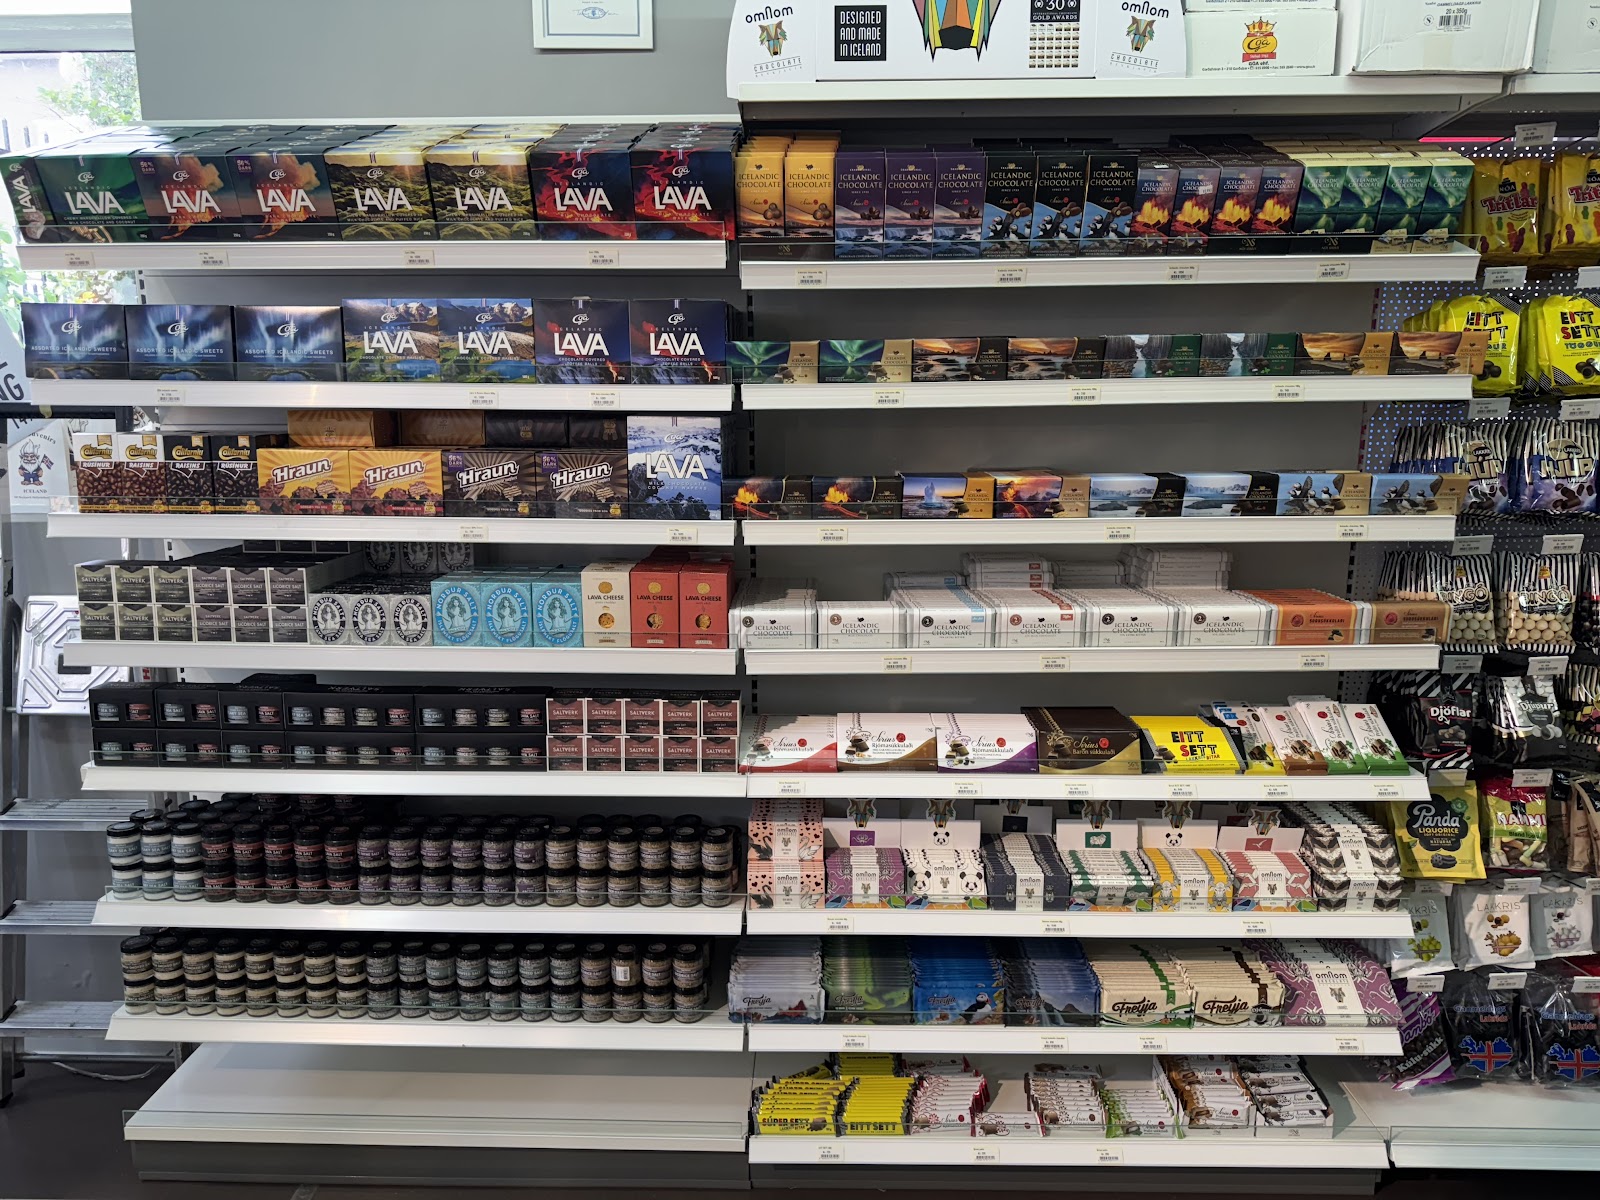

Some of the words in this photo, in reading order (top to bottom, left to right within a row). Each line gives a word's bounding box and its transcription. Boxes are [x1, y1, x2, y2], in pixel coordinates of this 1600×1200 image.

[745, 6, 793, 23] omnom
[1046, 0, 1065, 11] 30
[1121, 1, 1170, 18] omnom
[840, 11, 881, 24] DESIGNED
[840, 27, 855, 40] AND
[858, 27, 881, 40] MADE
[840, 43, 848, 56] IN
[850, 43, 881, 56] ICELAND
[840, 173, 881, 181] ICELANDIC
[890, 173, 932, 181] ICELANDIC
[987, 179, 1034, 187] CHOCOLATE
[990, 171, 1032, 179] ICELANDIC
[1038, 179, 1084, 187] CHOCOLATE
[1089, 178, 1136, 186] CHOCOLATE
[1092, 170, 1134, 178] ICELANDIC
[12, 175, 36, 212] LAVA
[837, 181, 883, 189] CHOCOLATE
[888, 181, 934, 189] CHOCOLATE
[65, 192, 125, 215] LAVA
[161, 190, 221, 213] LAVA
[256, 188, 316, 212] LAVA
[354, 187, 413, 211] LAVA
[454, 187, 514, 211] LAVA
[554, 187, 613, 211] LAVA
[653, 186, 712, 210] LAVA
[1466, 311, 1504, 326] EITT
[1560, 311, 1594, 326] EITT
[363, 331, 418, 354] LAVA
[457, 331, 514, 354] LAVA
[554, 332, 610, 356] LAVA
[649, 332, 705, 356] LAVA
[272, 459, 332, 484] Hraun
[365, 461, 425, 485] Hraun
[459, 462, 516, 486] Hraun
[553, 464, 611, 487] Hraun
[646, 453, 708, 480] LAVA
[463, 590, 477, 613] SALT
[513, 592, 527, 614] SALT
[564, 592, 578, 613] SALT
[1171, 731, 1204, 743] EITT
[1180, 745, 1217, 757] SETT
[1412, 804, 1461, 828] Panda
[1112, 997, 1158, 1017] Freyja
[1203, 997, 1250, 1016] Freyja
